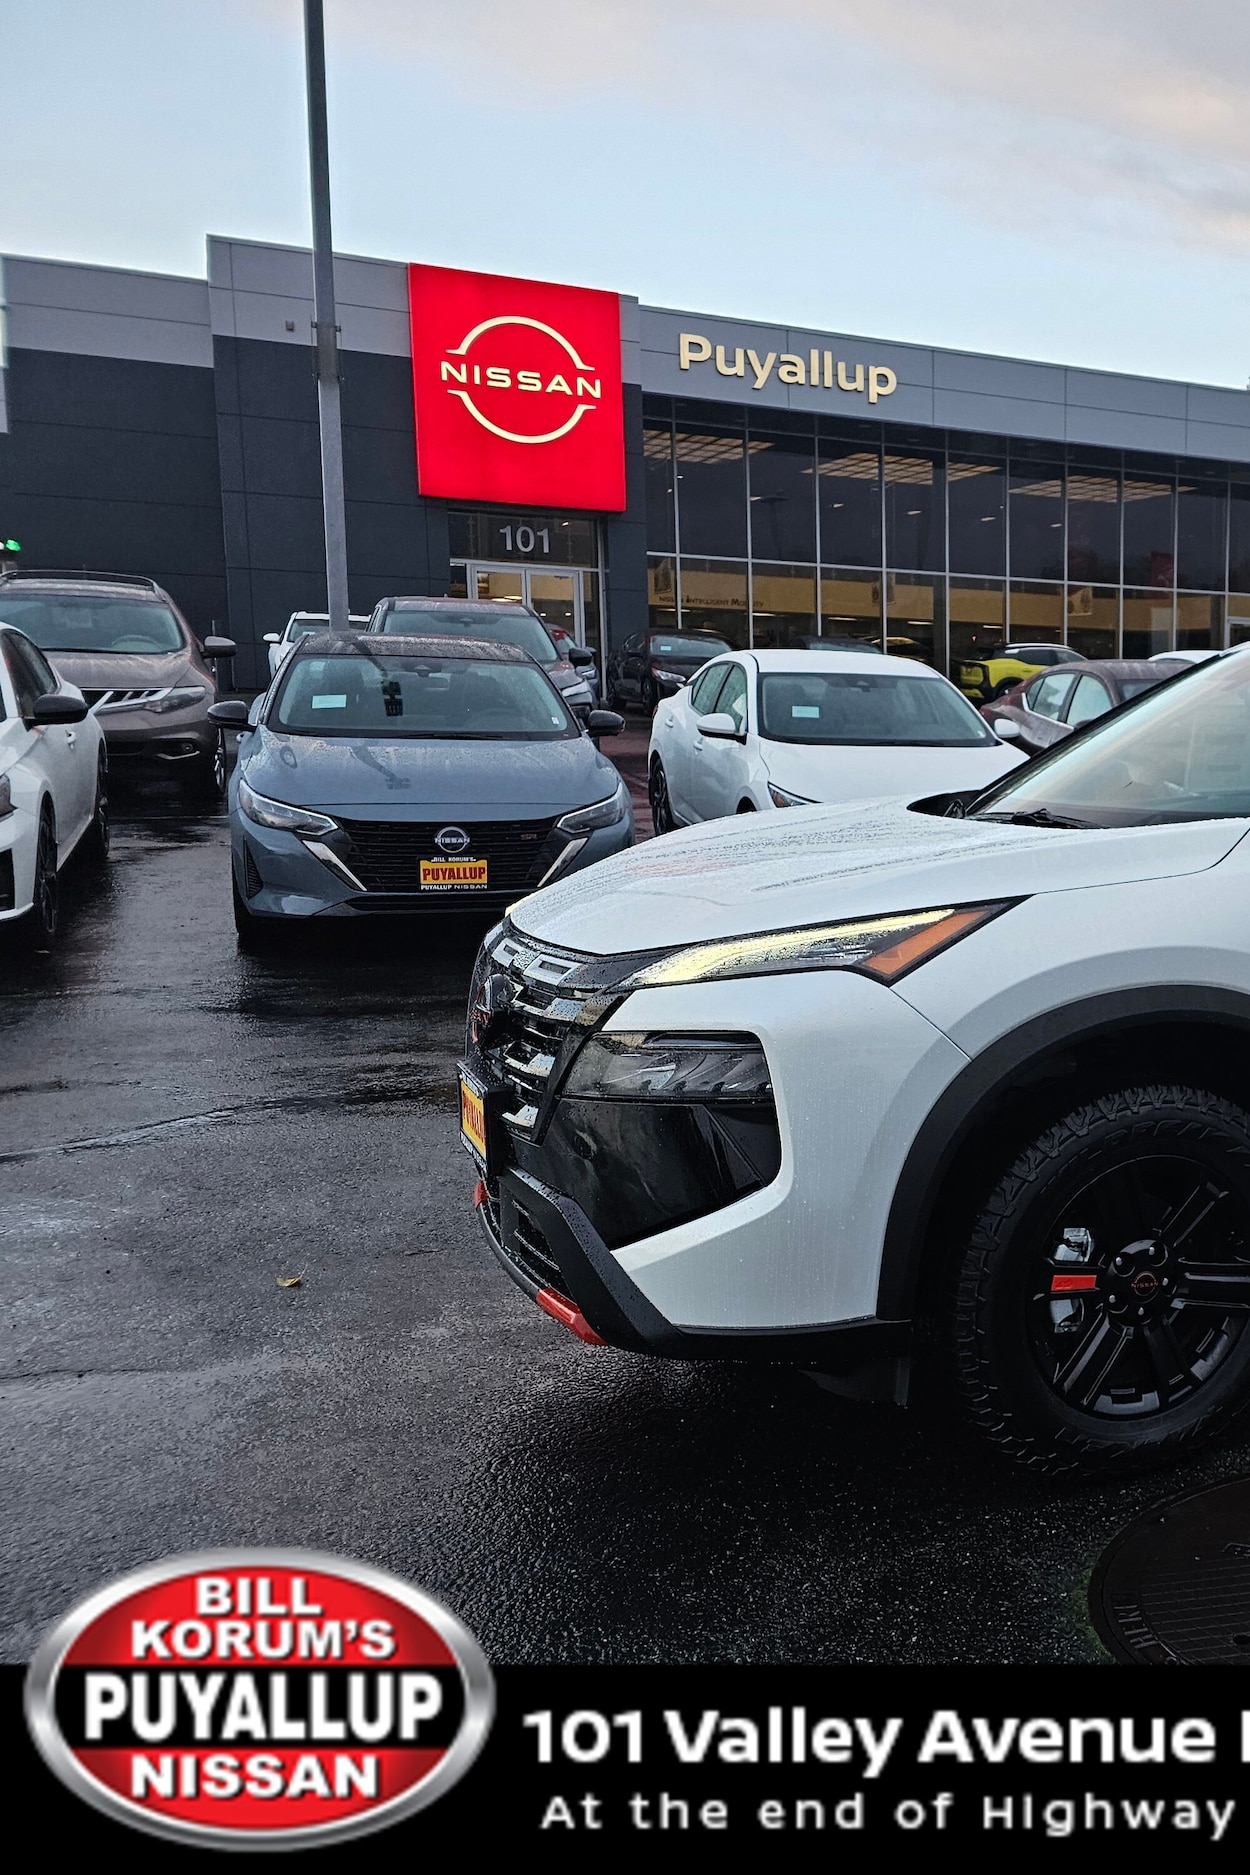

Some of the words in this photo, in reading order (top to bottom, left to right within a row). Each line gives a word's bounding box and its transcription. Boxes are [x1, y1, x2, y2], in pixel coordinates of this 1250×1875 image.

[440, 360, 602, 399] NISSAN
[679, 332, 898, 404] Puyallup
[499, 525, 550, 554] 101
[434, 836, 470, 845] NISSAN
[422, 866, 486, 881] PUYALLUP
